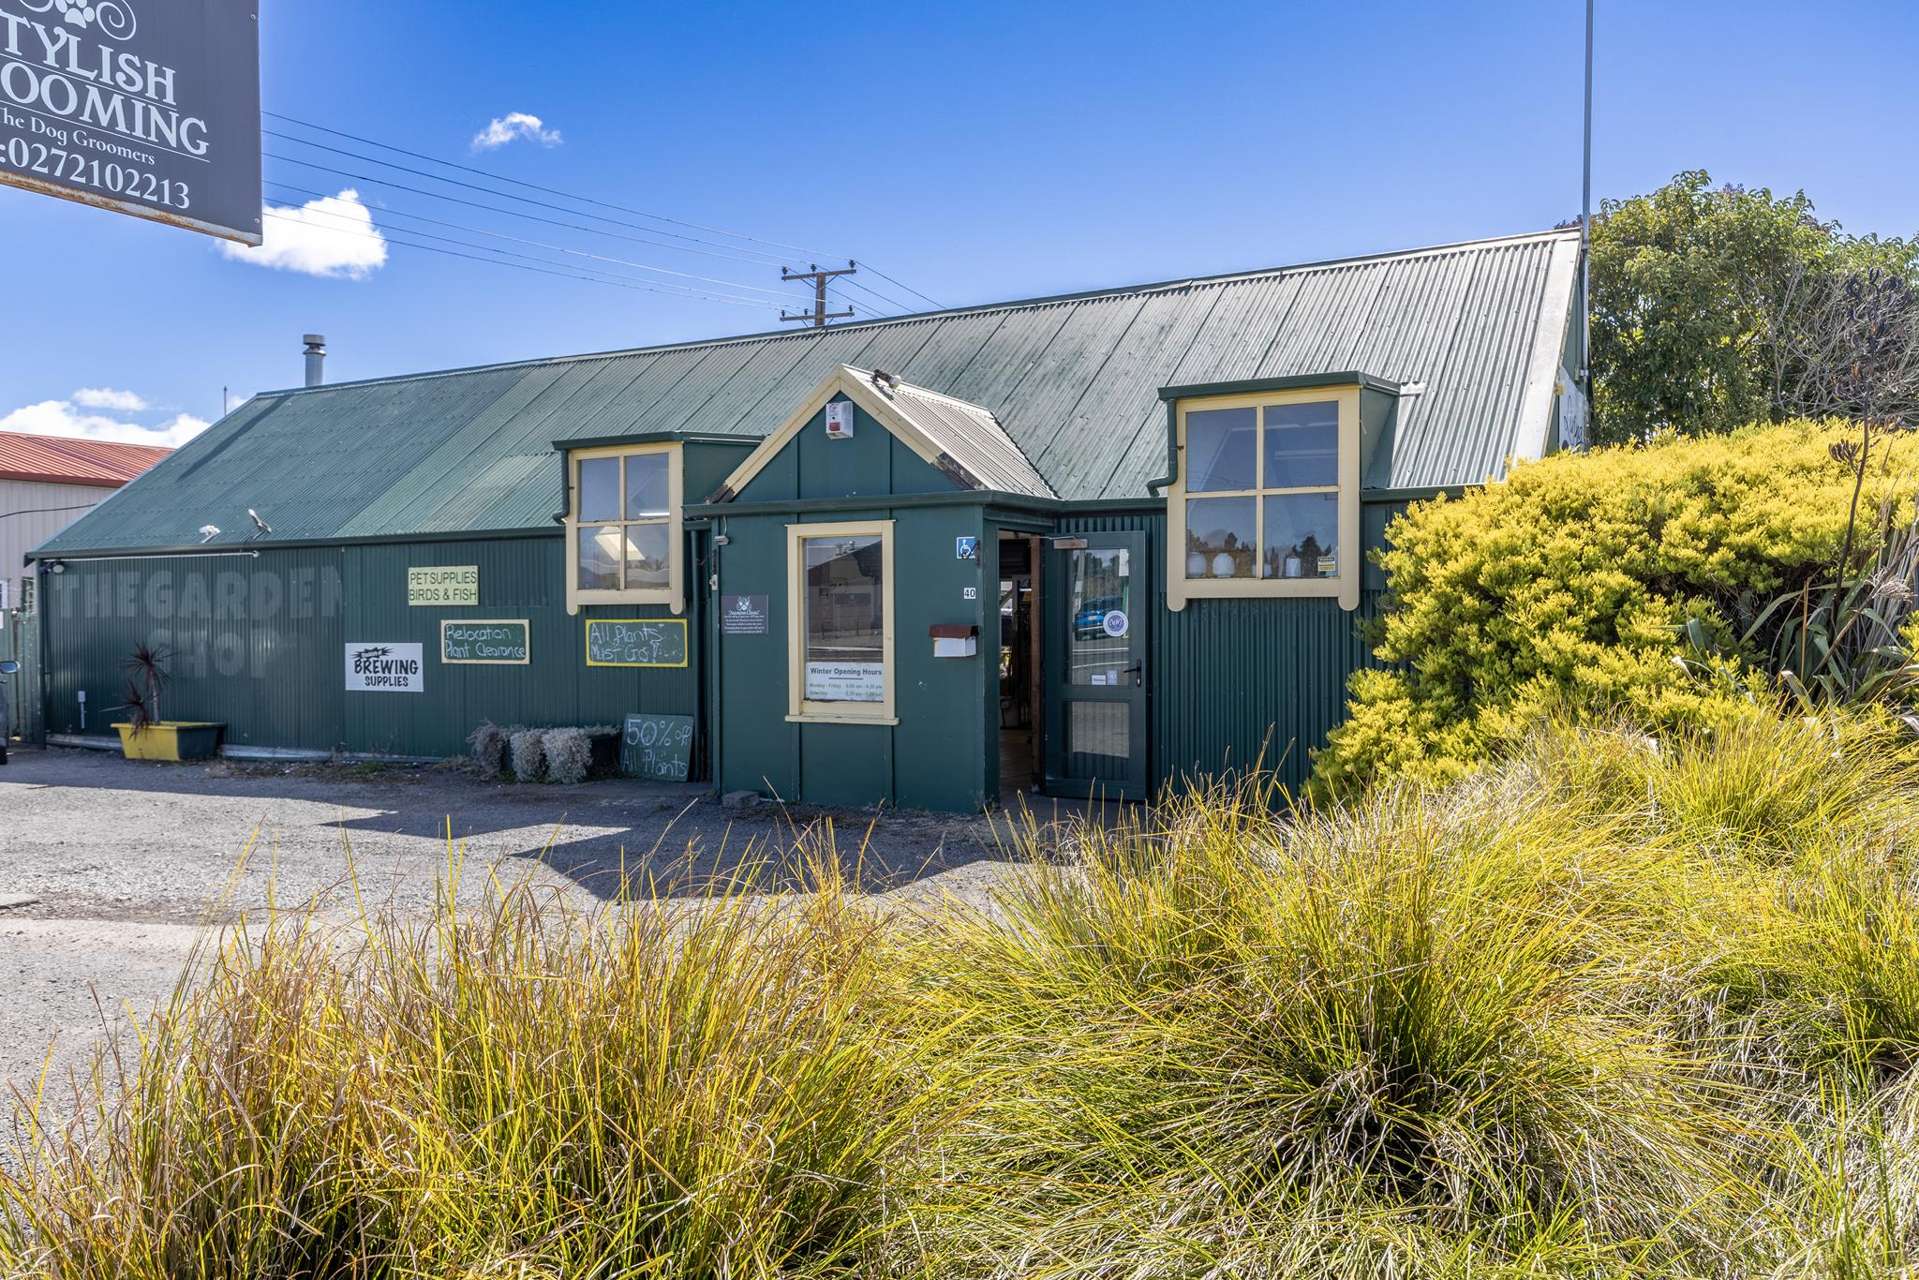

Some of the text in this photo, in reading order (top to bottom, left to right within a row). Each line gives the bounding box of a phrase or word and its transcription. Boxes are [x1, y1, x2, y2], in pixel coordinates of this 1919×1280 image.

[1, 61, 209, 155] OOMING
[0, 107, 156, 165] he Dog Groomers
[54, 571, 142, 619] THE
[409, 588, 477, 601] BIRDS & FISH
[964, 588, 976, 598] 40
[446, 624, 511, 640] Relocation
[591, 623, 664, 646] All Plants
[446, 641, 527, 658] Plant Clearance
[354, 659, 418, 675] BREWING
[810, 667, 882, 676] Winter Opening Hours
[365, 676, 408, 687] SUPPLIES
[627, 719, 674, 746] 50%
[622, 749, 688, 777] All Plants
